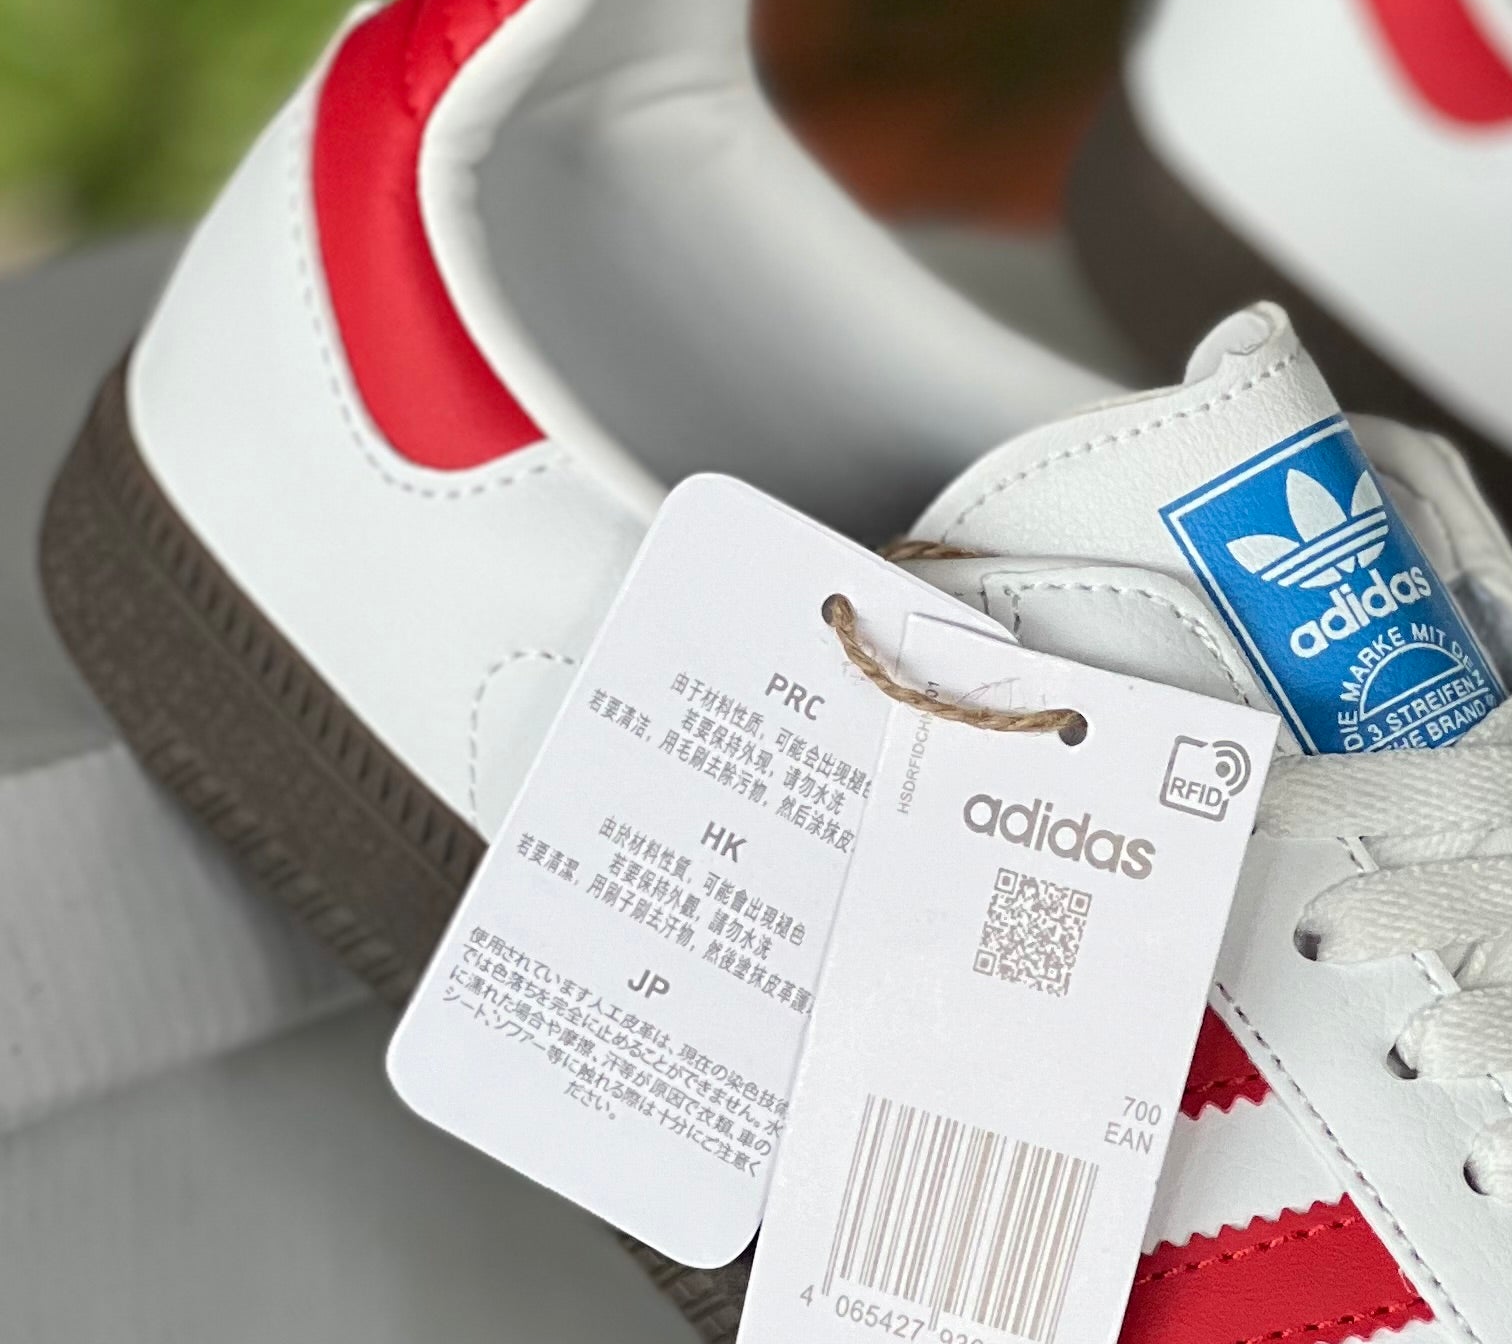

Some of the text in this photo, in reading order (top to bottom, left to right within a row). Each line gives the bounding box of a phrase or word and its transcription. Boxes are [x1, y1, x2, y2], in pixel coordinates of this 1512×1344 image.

[1290, 566, 1431, 659] adidas
[1411, 623, 1446, 646] MIT
[1340, 626, 1406, 702] MARKE
[764, 672, 826, 721] PRC
[1368, 724, 1383, 742] 3
[1386, 676, 1475, 732] STREIFEN
[1338, 710, 1364, 752] DIE
[1425, 699, 1486, 741] BRAND
[1169, 776, 1223, 807] RFID
[700, 820, 747, 863] HK
[963, 794, 1156, 880] adidas
[627, 968, 671, 999] JP
[562, 1080, 617, 1121] ださい。
[1122, 1095, 1162, 1126] 700
[1104, 1121, 1154, 1155] EAN
[799, 1284, 815, 1308] 4
[835, 1294, 925, 1342] 065427
